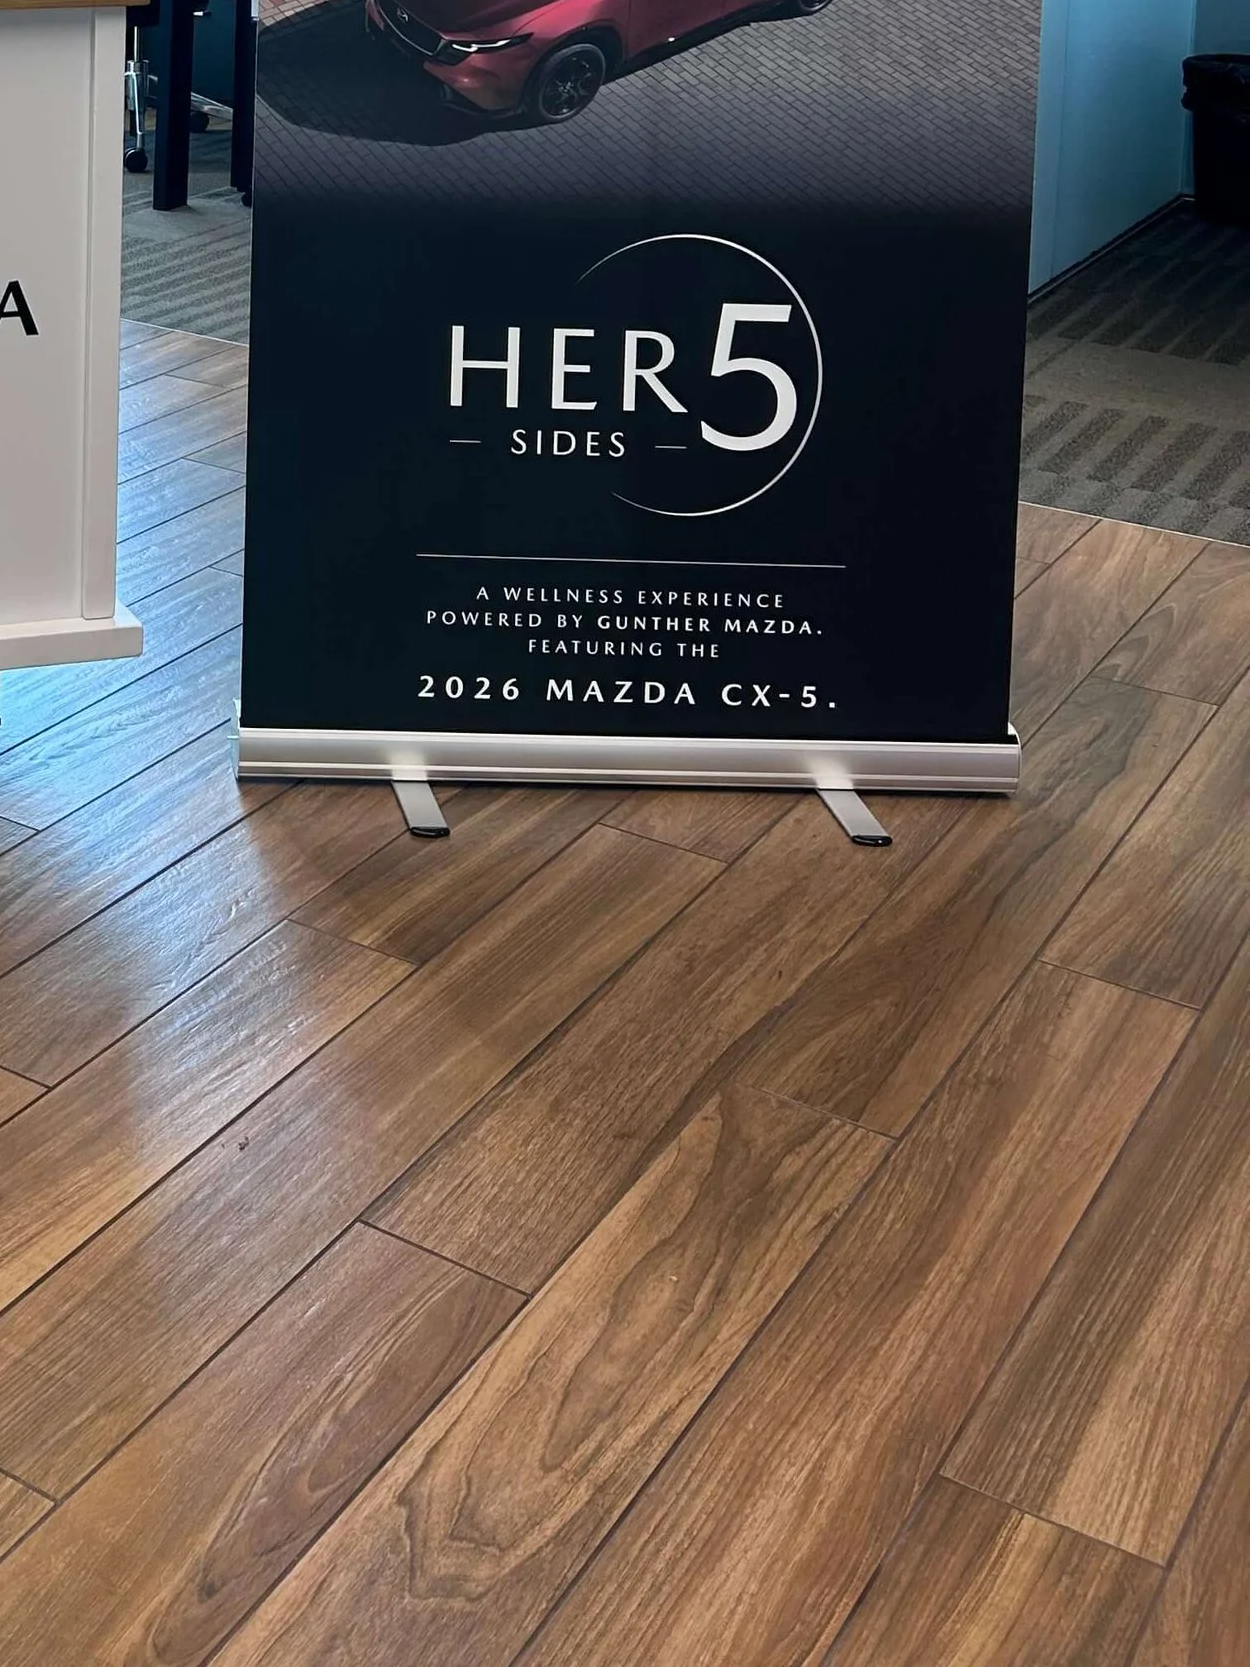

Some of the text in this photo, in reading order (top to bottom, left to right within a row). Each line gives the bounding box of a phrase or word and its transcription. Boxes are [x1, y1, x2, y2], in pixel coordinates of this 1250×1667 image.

[450, 303, 797, 451] HER 5
[510, 429, 625, 458] SIDES
[476, 586, 784, 608] A WELLNESS EXPERIENCE
[427, 610, 822, 635] POWERED BY GUNTHER MAZDA.
[528, 639, 720, 658] FEATURING THE
[417, 675, 837, 709] 2026 MAZDA CX-5.
